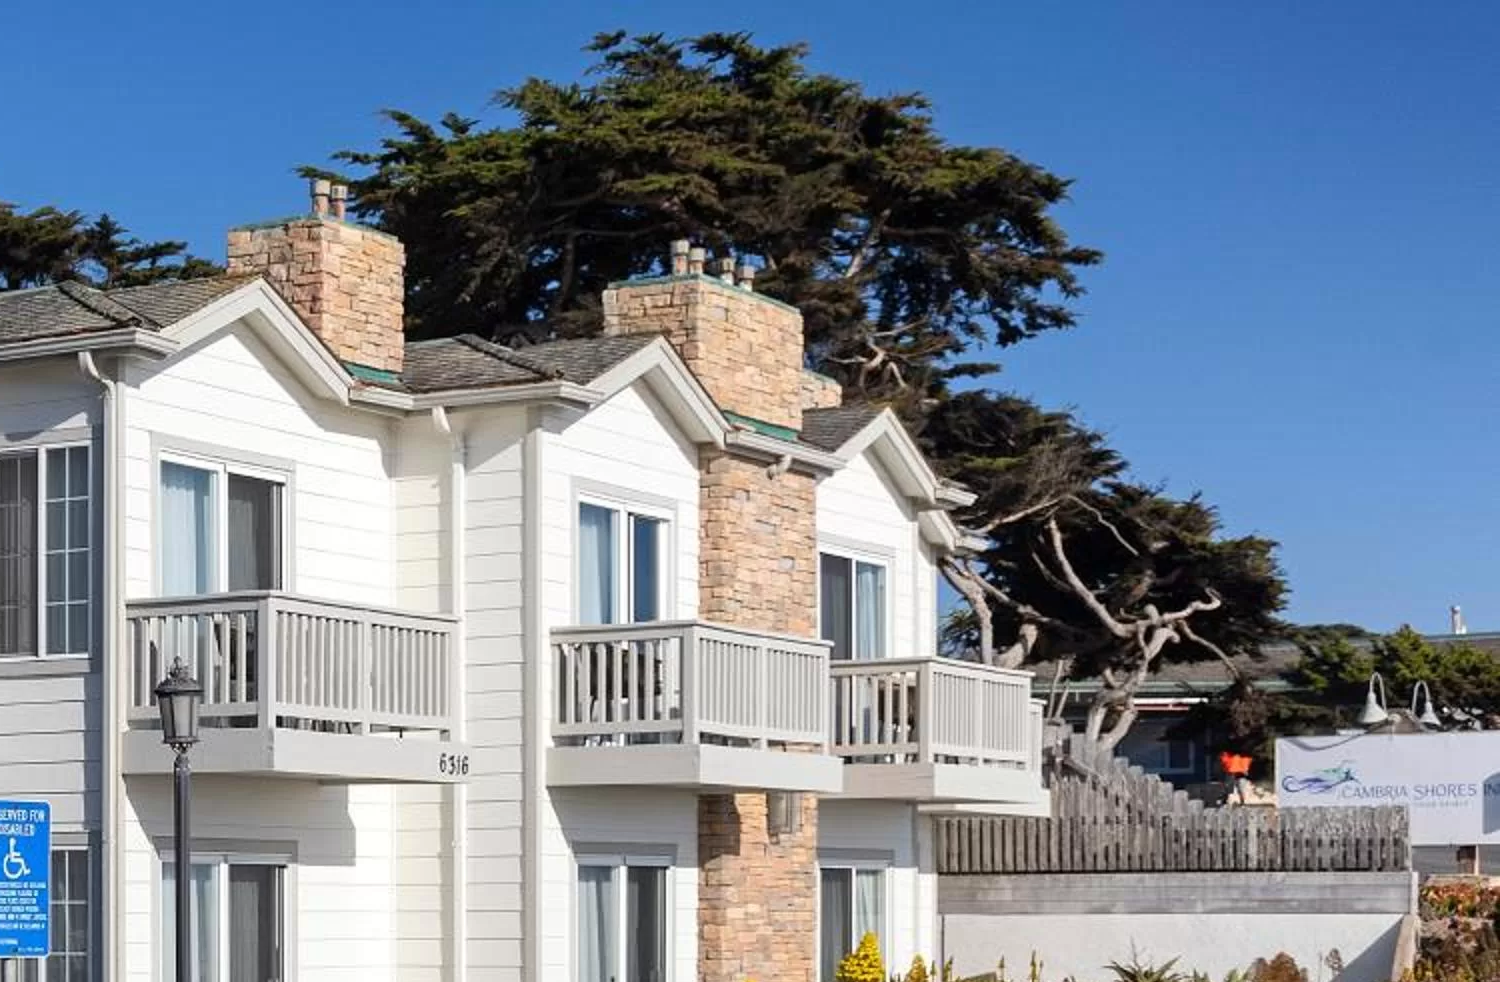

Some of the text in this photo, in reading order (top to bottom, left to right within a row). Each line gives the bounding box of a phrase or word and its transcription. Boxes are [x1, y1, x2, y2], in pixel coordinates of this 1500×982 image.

[439, 752, 469, 775] 6316
[1340, 784, 1409, 800] CAMBRIA
[1414, 783, 1477, 800] SHORES
[29, 809, 45, 823] FOR
